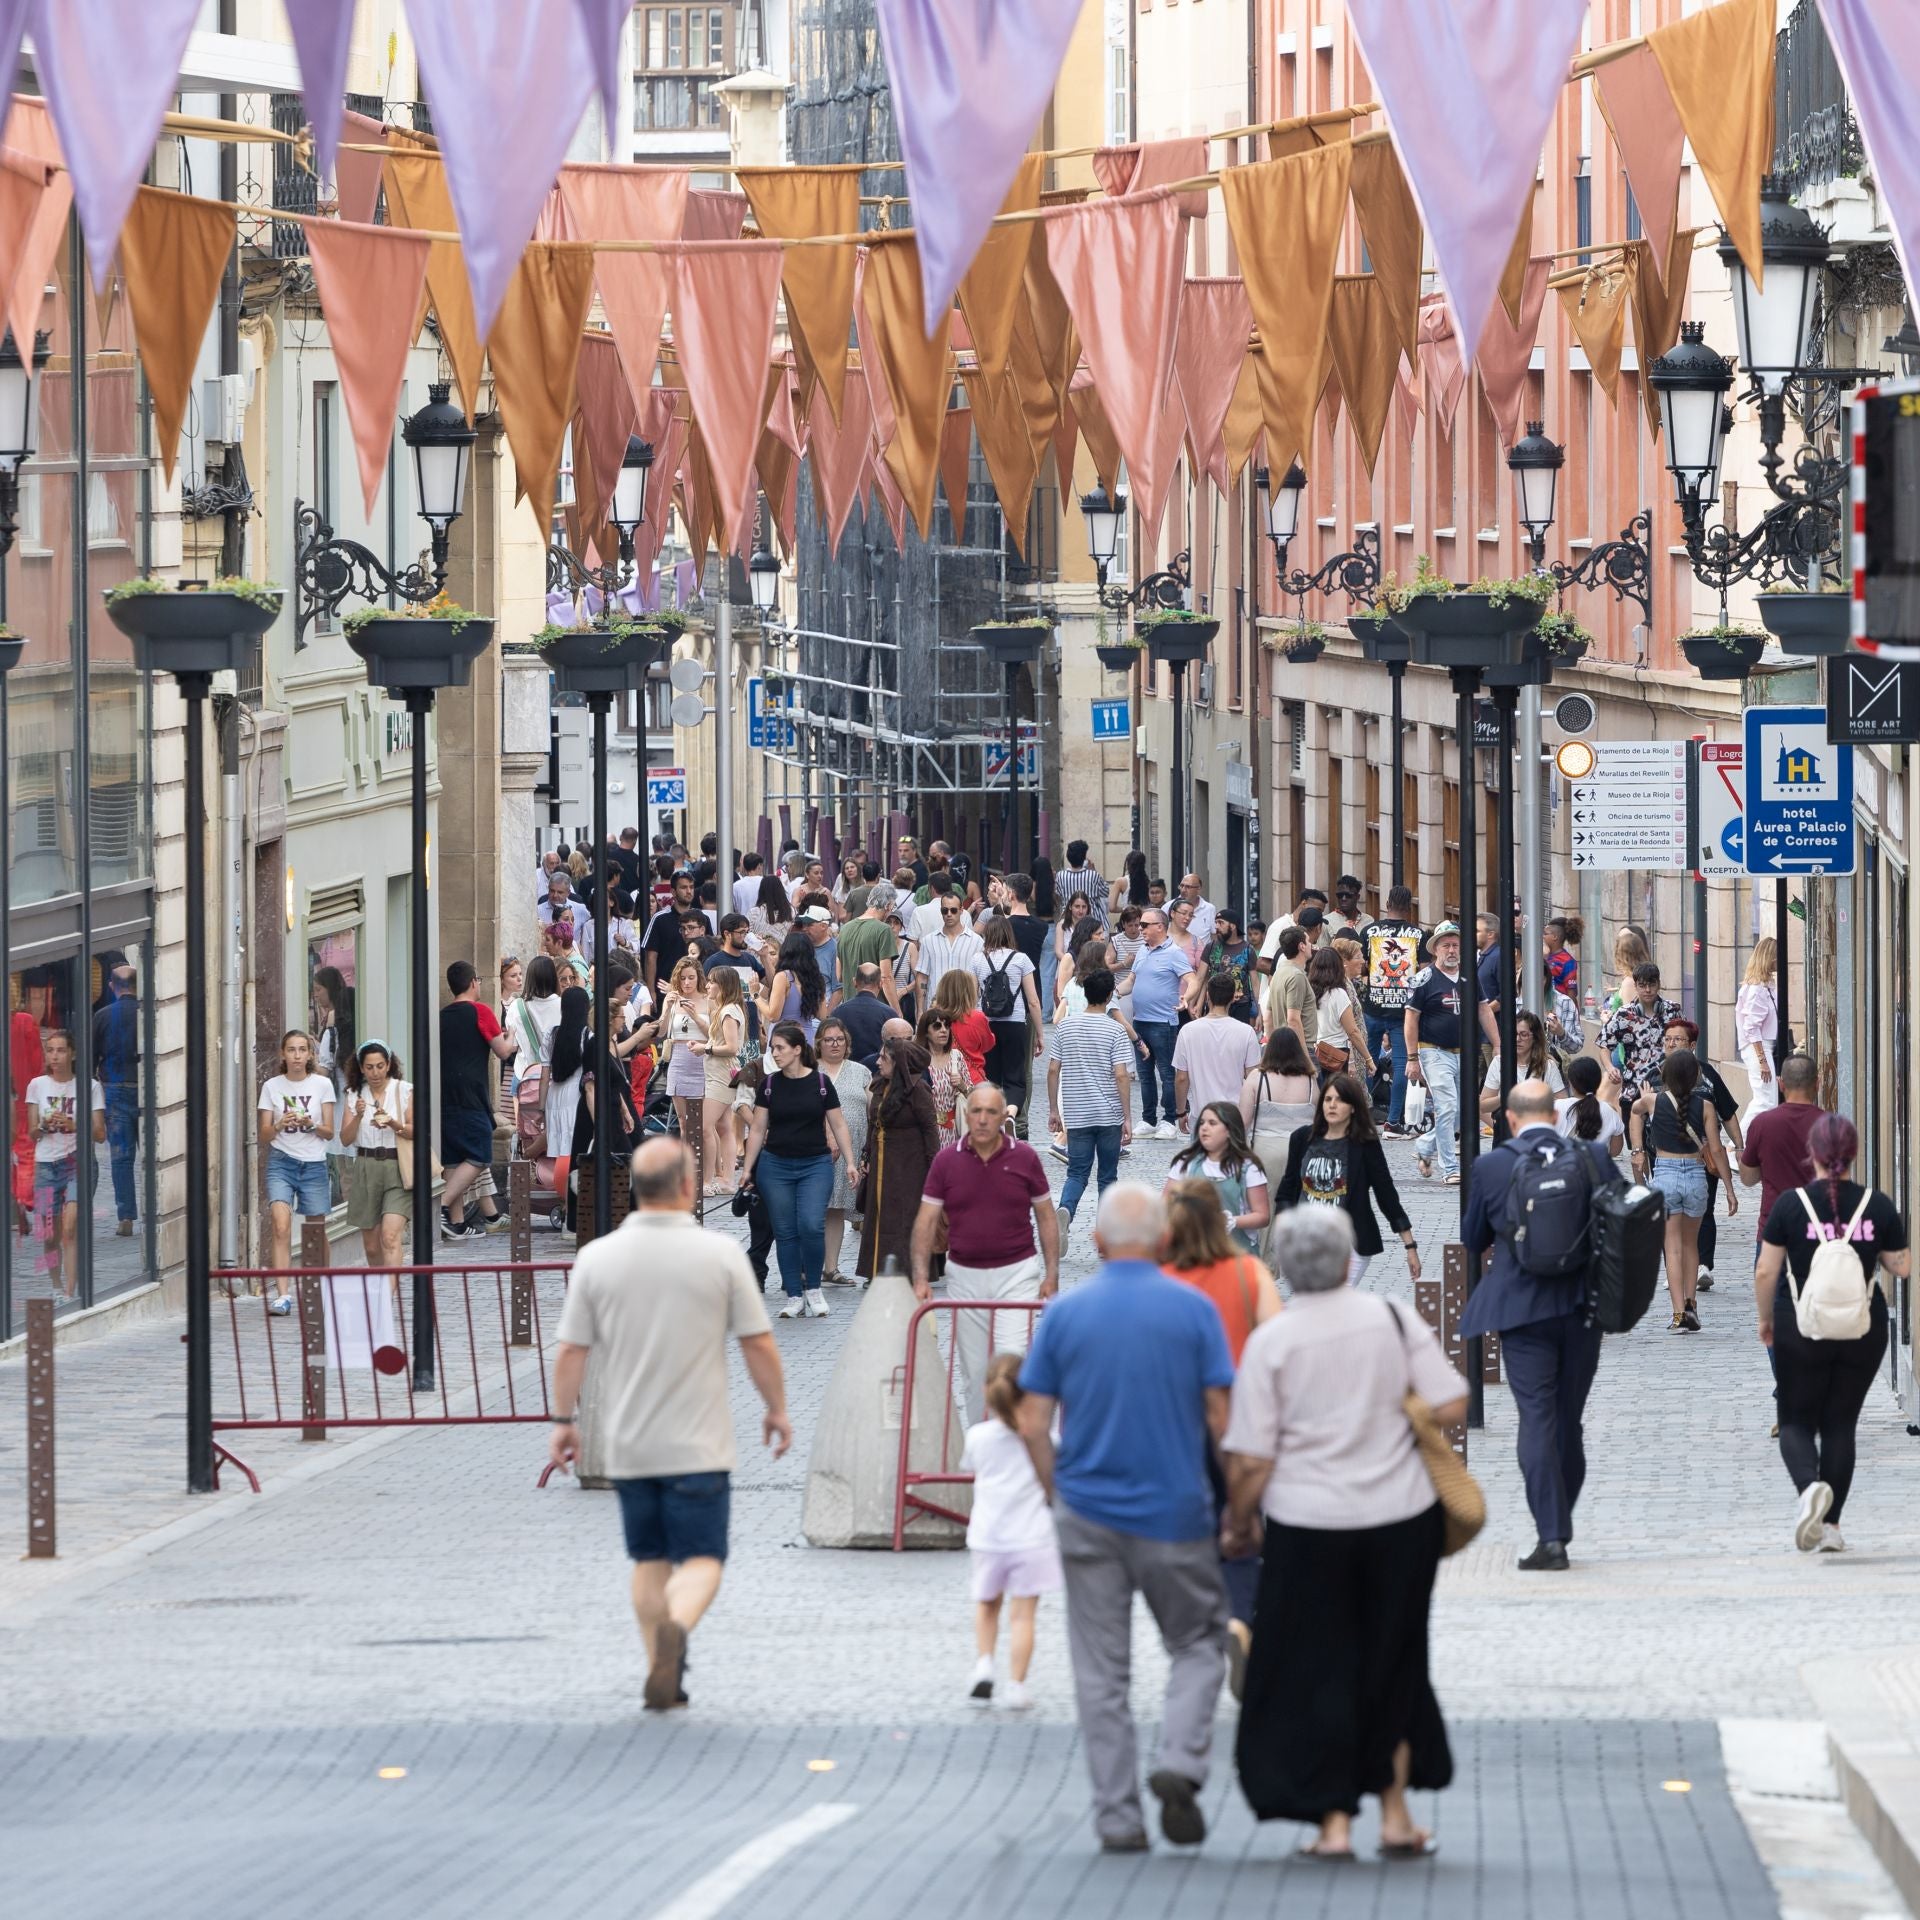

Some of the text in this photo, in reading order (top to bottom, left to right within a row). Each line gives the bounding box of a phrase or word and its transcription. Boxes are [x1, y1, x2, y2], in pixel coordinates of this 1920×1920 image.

[1849, 720, 1901, 729] MORE ART
[1596, 747, 1631, 755] arlamento
[1652, 746, 1670, 755] Rioja
[1719, 750, 1743, 760] Logro
[1783, 808, 1817, 819] hotel
[1754, 820, 1847, 833] Áurea Palacio
[1763, 836, 1838, 846] de Correos
[1622, 855, 1670, 863] Ayuntamiento
[1370, 987, 1382, 995] WE
[1369, 996, 1407, 1004] THE FUTU
